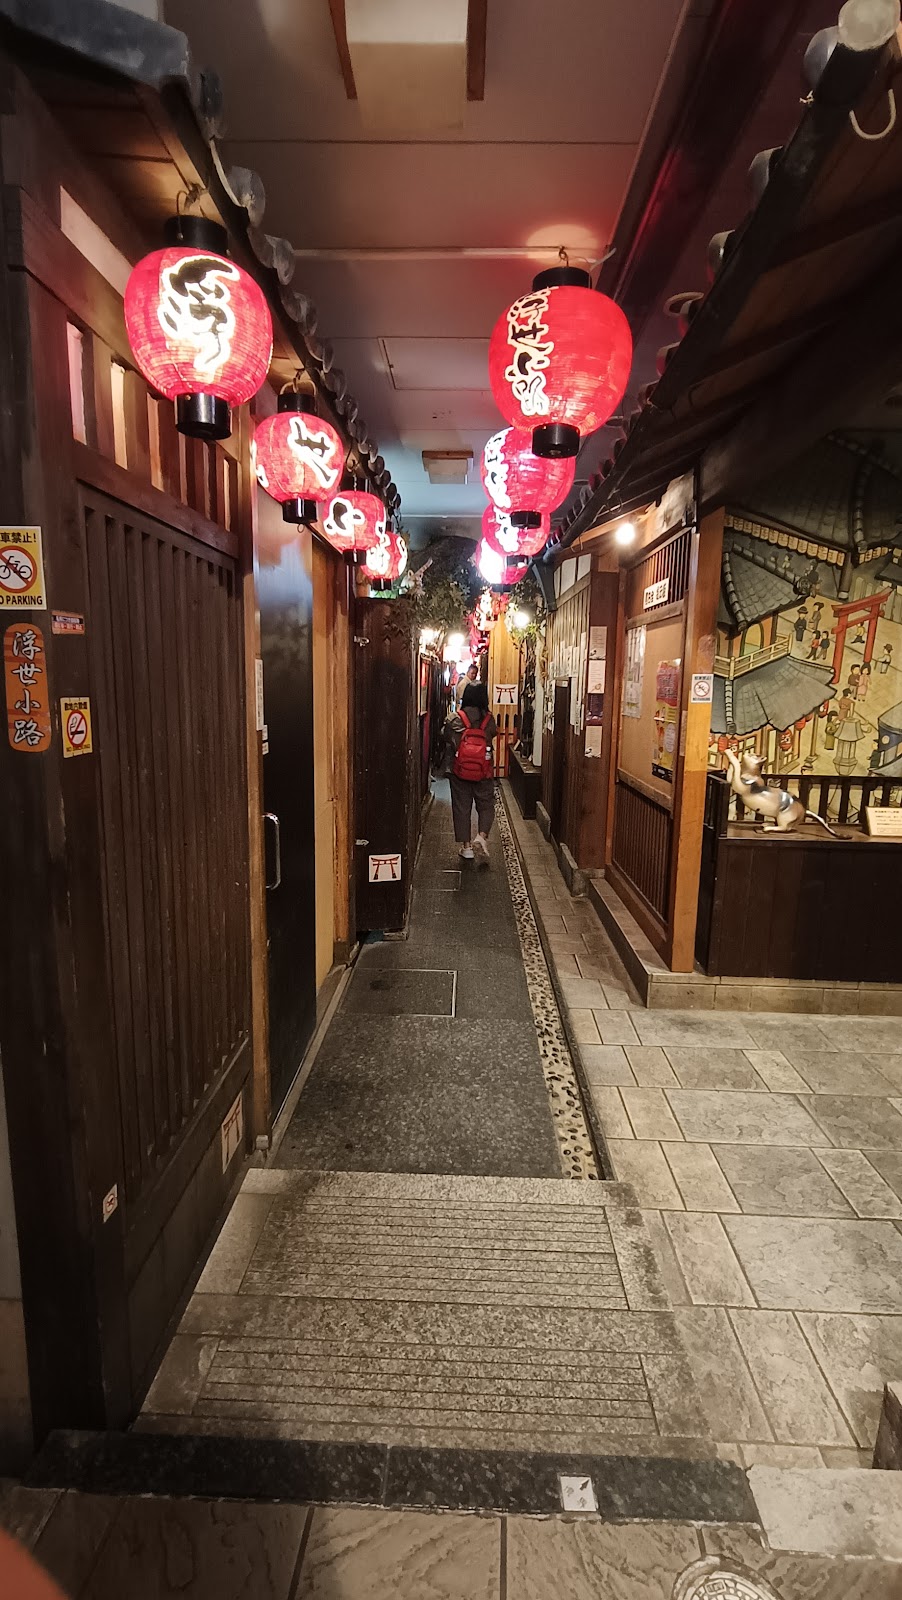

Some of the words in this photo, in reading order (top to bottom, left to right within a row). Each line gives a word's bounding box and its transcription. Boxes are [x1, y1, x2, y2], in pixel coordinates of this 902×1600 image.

[6, 596, 43, 605] PARKING
[12, 630, 45, 745] 浮世小路
